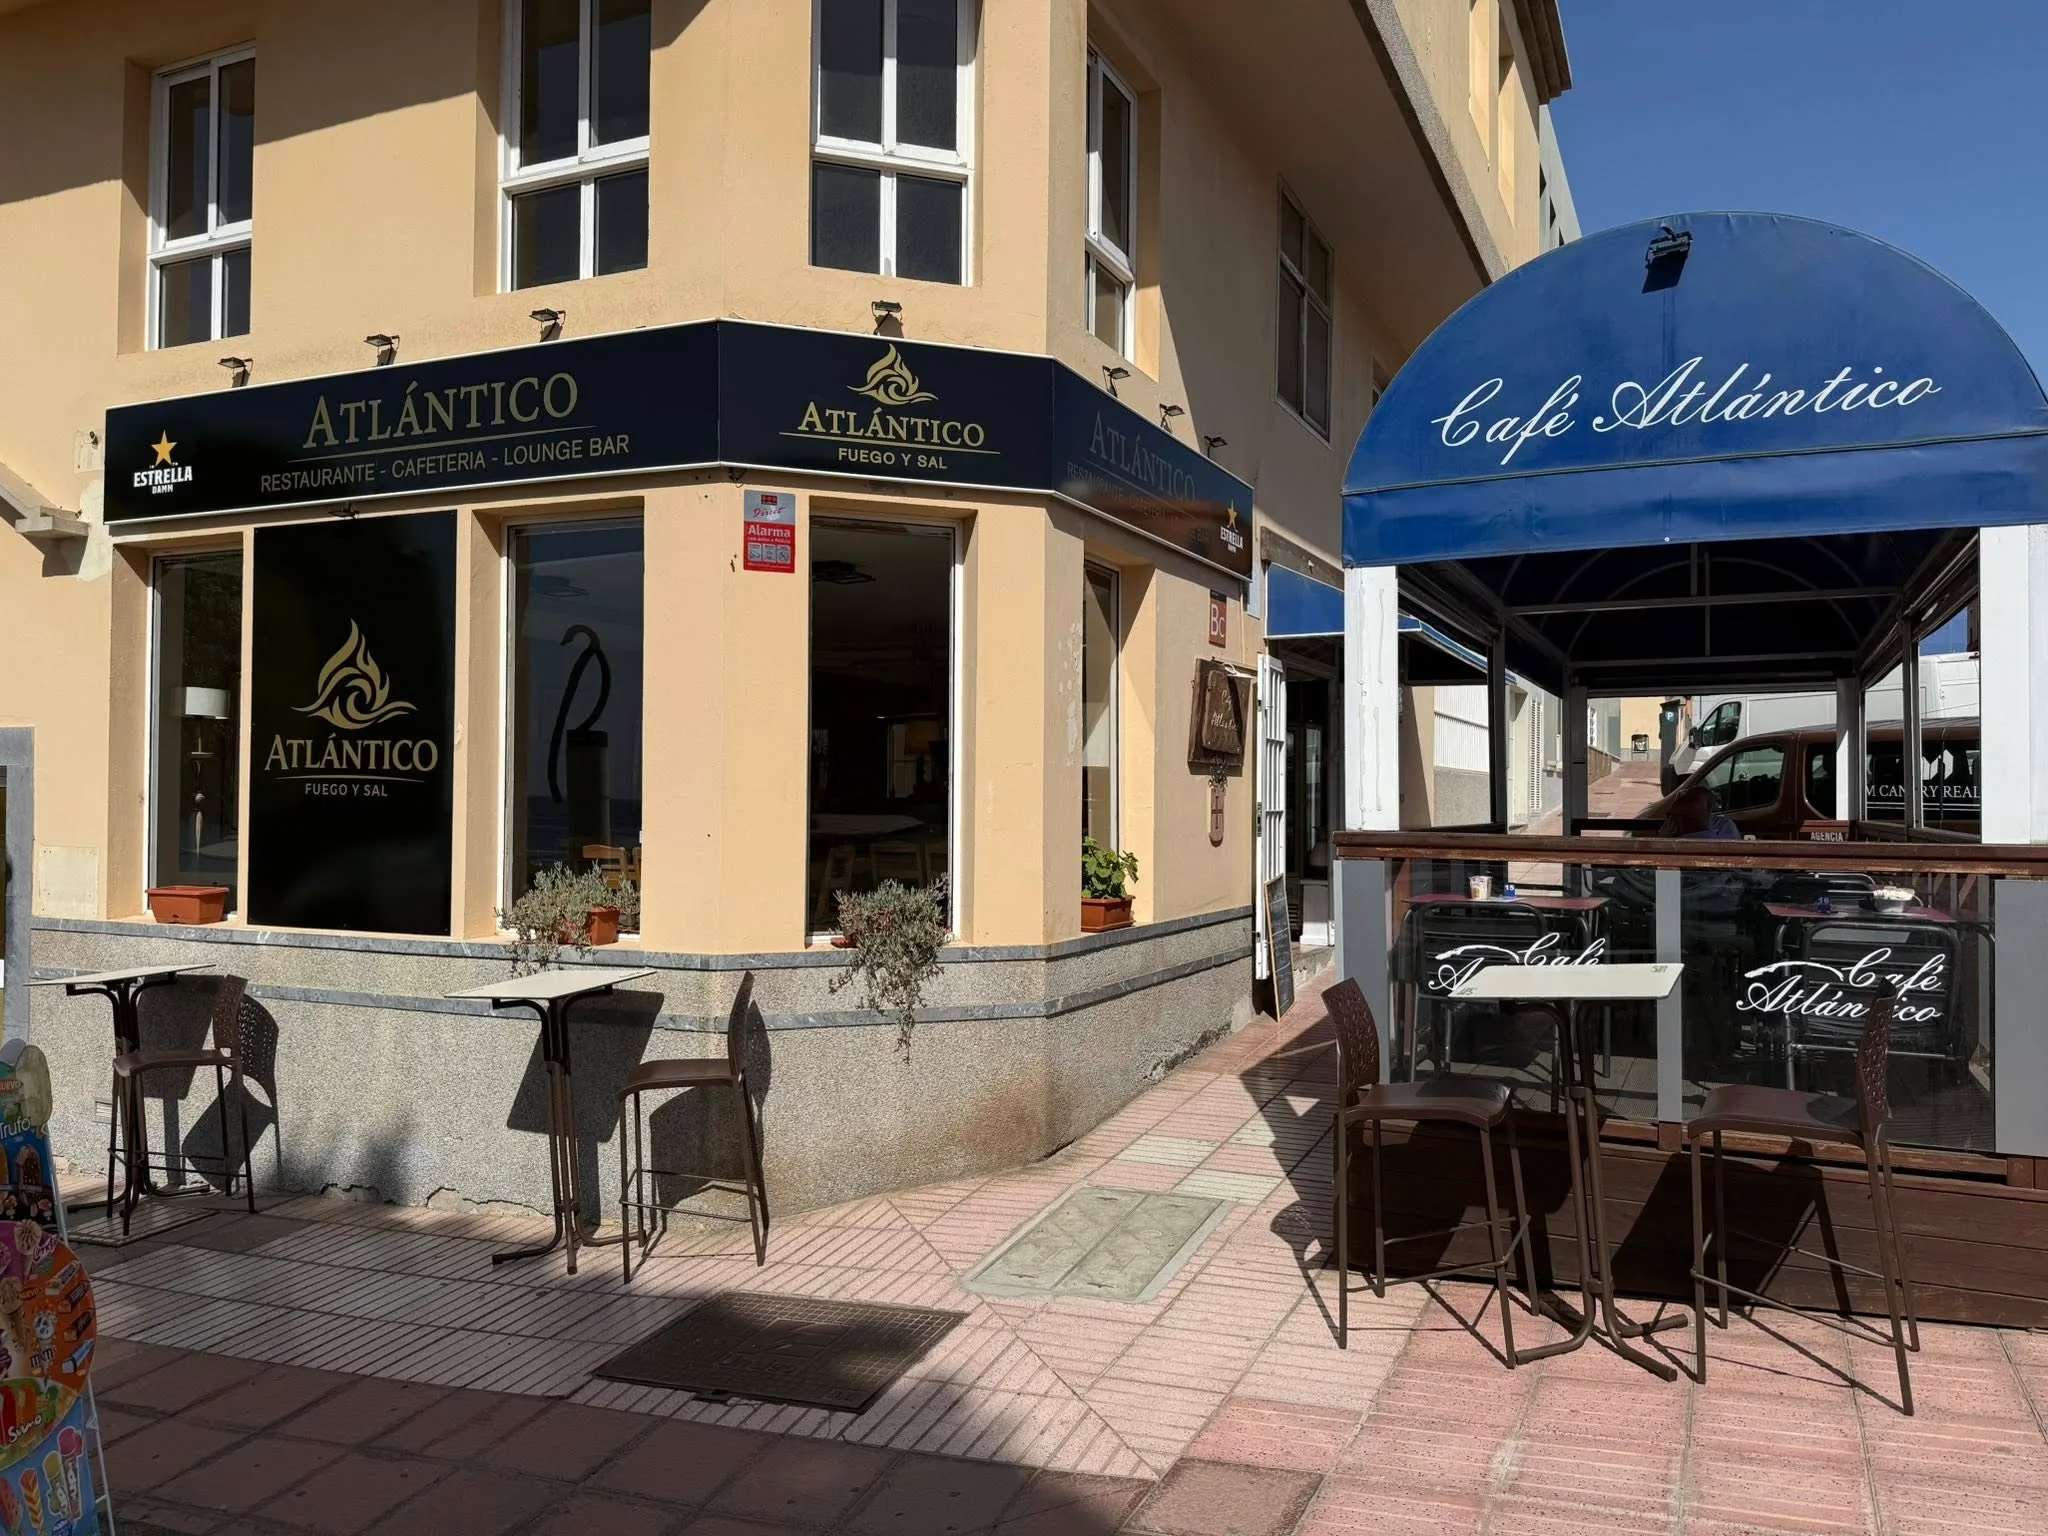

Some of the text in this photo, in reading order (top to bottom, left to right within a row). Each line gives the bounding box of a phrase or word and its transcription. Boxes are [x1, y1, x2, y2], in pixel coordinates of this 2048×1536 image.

[302, 372, 578, 449] ATLÁNTICO
[797, 401, 985, 447] ATLÁNTICO
[1430, 356, 1943, 465] Café Atlántico
[260, 463, 376, 493] RESTAURANTE
[391, 450, 486, 479] CAFETERIA
[503, 439, 583, 466] LOUNGE
[589, 434, 630, 456] BAR
[838, 447, 948, 470] FUEGO Y SAL
[1089, 411, 1196, 504] ATLÁNTICO
[133, 466, 193, 488] ESTRELLA
[748, 524, 791, 538] Alarma
[1210, 602, 1225, 638] Bc
[263, 732, 439, 772] ATLÁNTICO
[305, 783, 389, 797] FUEGO Y SAL
[1879, 784, 1938, 798] CANRY
[1810, 831, 1844, 842] AGENCIA
[1736, 974, 1944, 1022] Atlánico
[0, 1079, 21, 1091] UEVO
[8, 1414, 42, 1444] Sumo
